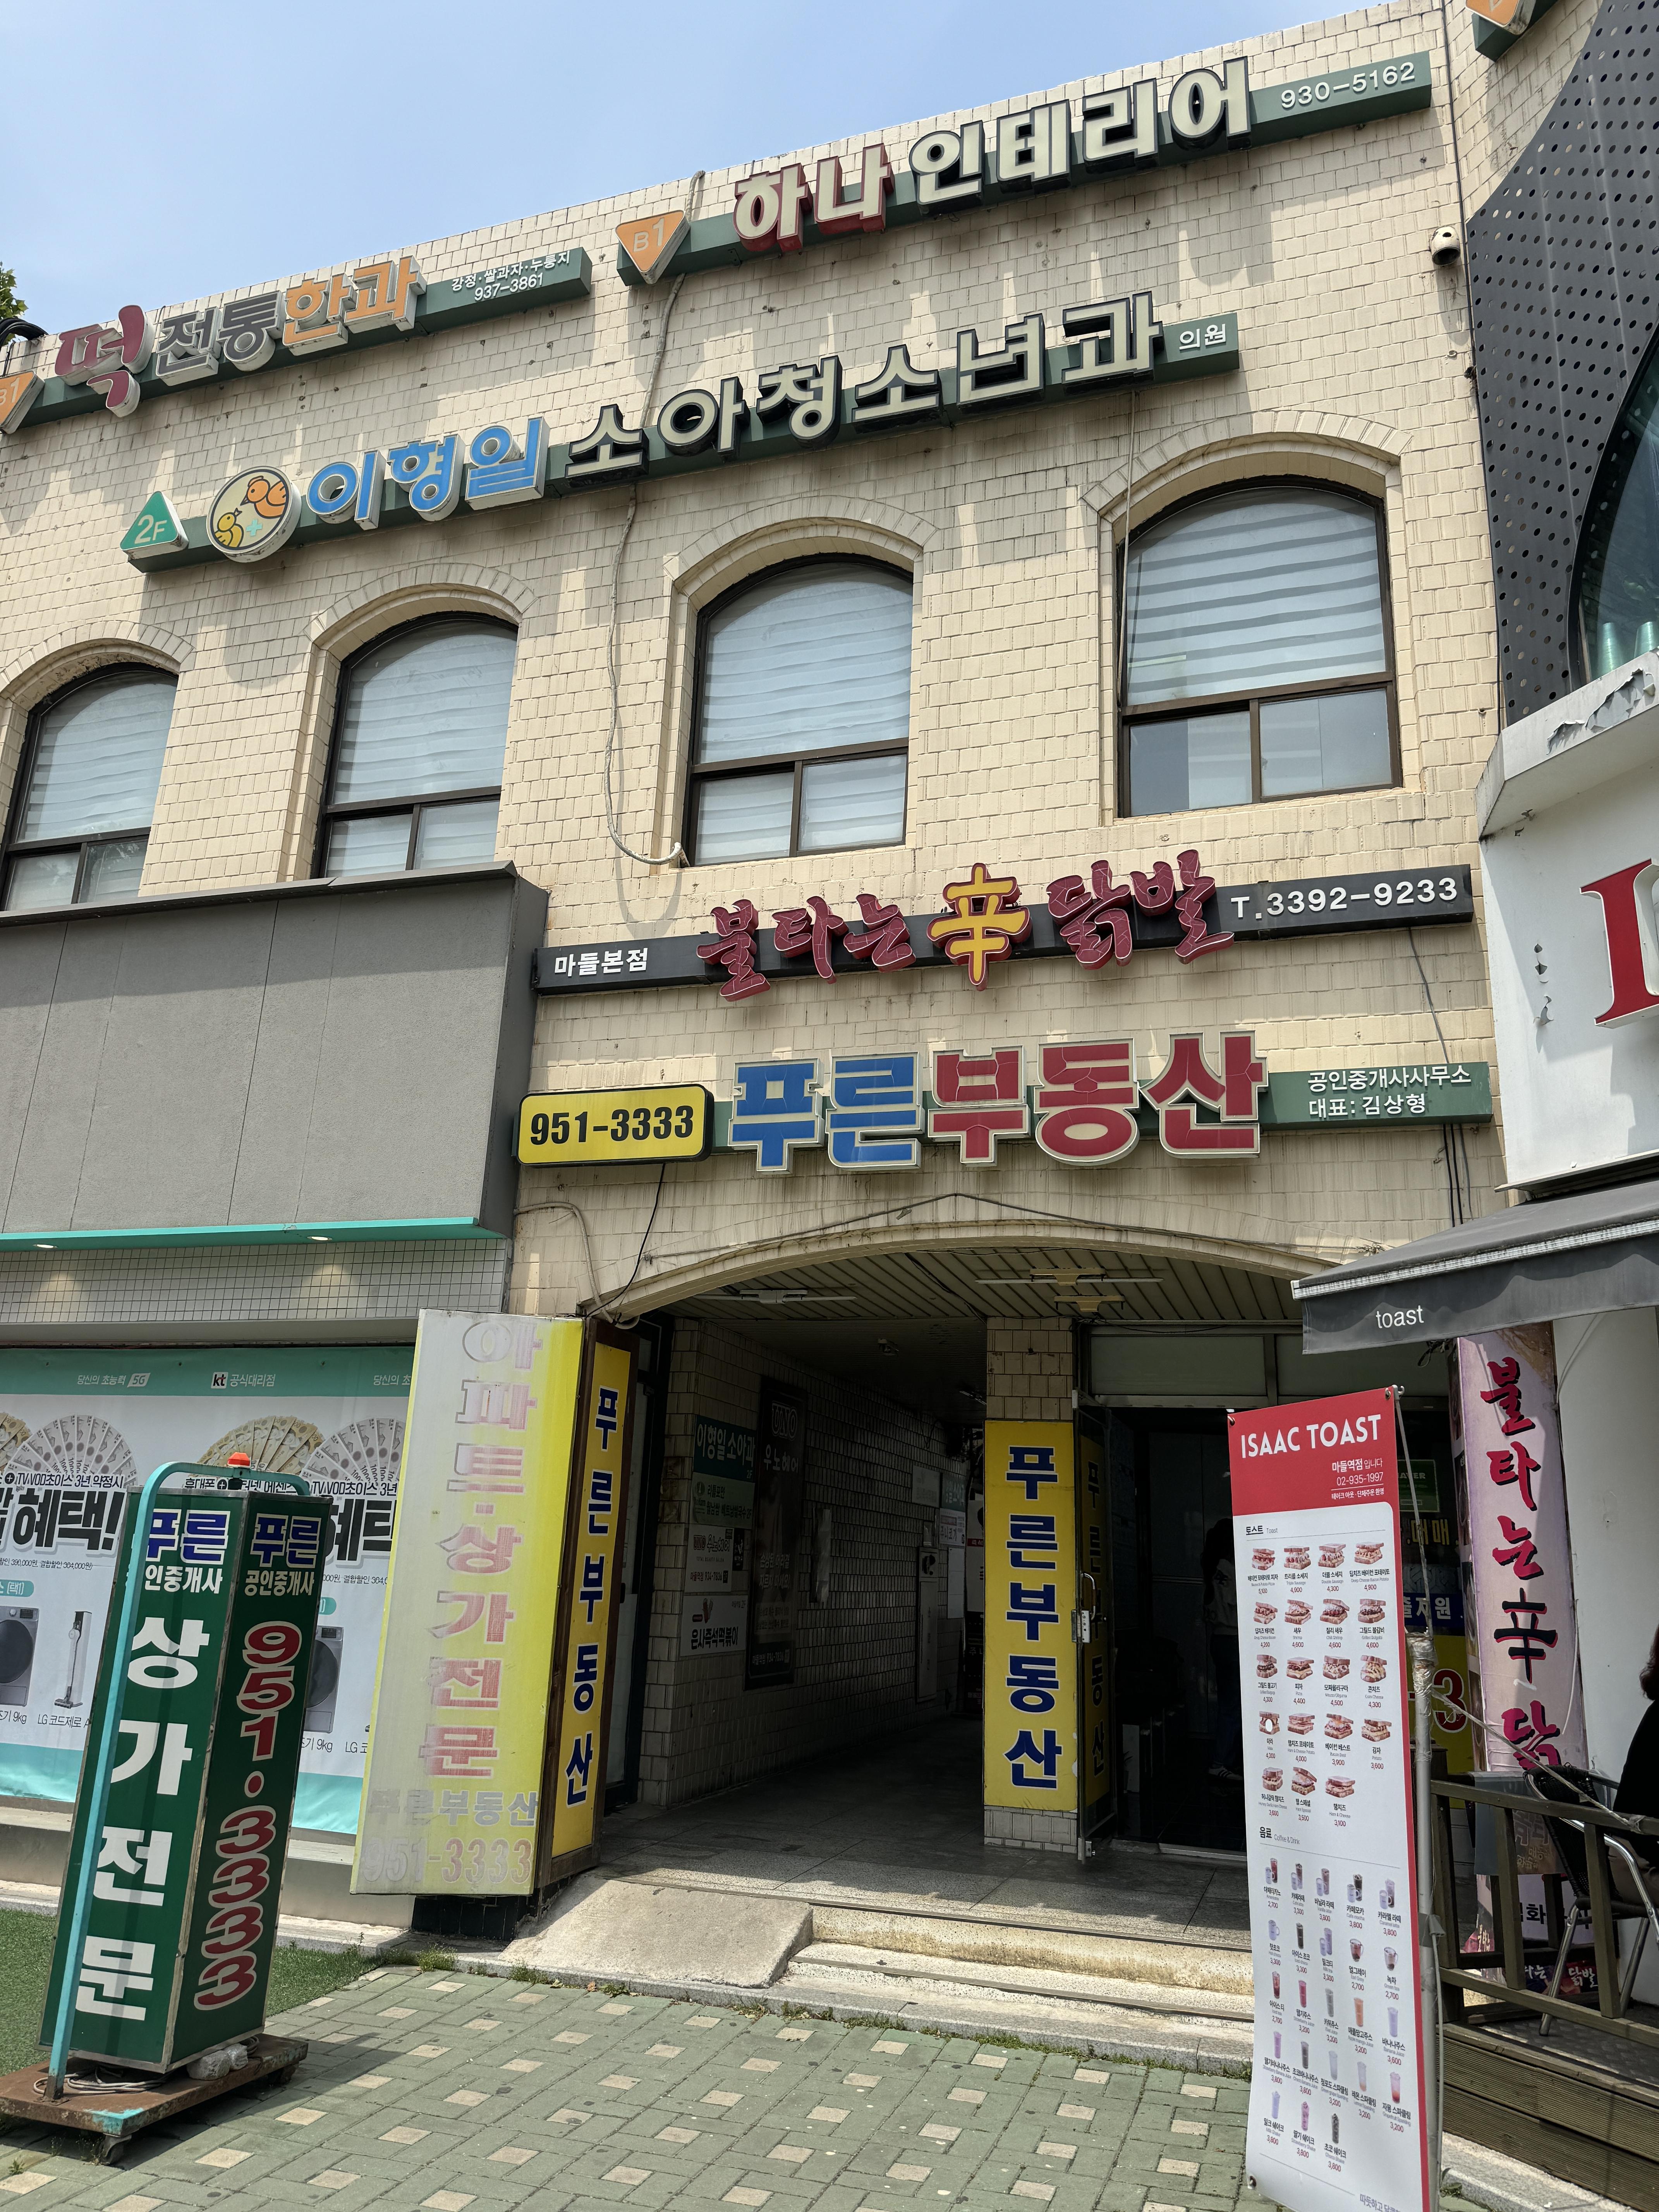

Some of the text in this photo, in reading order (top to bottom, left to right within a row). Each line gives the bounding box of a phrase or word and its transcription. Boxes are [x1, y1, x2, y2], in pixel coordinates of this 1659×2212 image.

[1281, 62, 1415, 110] 930-5162
[633, 216, 665, 253] B1
[474, 272, 543, 301] 937-3861
[1178, 323, 1226, 351] 의원
[135, 513, 167, 545] 2F
[554, 947, 649, 977] 마들본점
[1307, 1064, 1472, 1094] 공인중개사사무소
[1362, 1092, 1427, 1116] 김상형
[530, 1105, 694, 1146] 951-3333
[1376, 1305, 1424, 1329] toast
[77, 1373, 146, 1386] 당신의 초능력 5G
[212, 1373, 276, 1388] kt 공식대리점
[373, 1374, 399, 1386] 당신의
[771, 1400, 798, 1441] UNO
[1241, 1414, 1382, 1459] ISAAC TOAST
[697, 1424, 756, 1468] 이형일 소아과
[763, 1444, 799, 1474] 우노헤어
[1331, 1457, 1383, 1473] 마들역점 입니다
[74, 1475, 91, 1487] 3년
[93, 1475, 124, 1489] 약정시
[1336, 1472, 1384, 1486] 02-935-1997
[12, 1488, 125, 1551] 혜택!
[145, 1508, 230, 1565] 푸른
[1246, 1525, 1264, 1535] 토스트
[250, 1513, 322, 1569] 푸른
[144, 1565, 223, 1594] 인중개사
[244, 1569, 315, 1597] 공인중개사
[565, 1386, 618, 1807] 푸른부동산
[1003, 1445, 1063, 1790] 푸른부동산
[13, 1711, 82, 1728] 9kg LG 코드제로
[345, 1740, 359, 1753] LG
[76, 1617, 210, 2021] 상가전문
[1259, 1826, 1272, 1839] 음료
[362, 1835, 532, 1886] 951-3333
[1267, 1901, 1278, 1909] 2,700
[1346, 1905, 1364, 1915] 카페모카
[1349, 1920, 1362, 1929] 3,800
[1383, 1928, 1397, 1937] 3,800
[1349, 1965, 1366, 1978] 얼그레이
[1387, 1975, 1396, 1985] 녹차
[1352, 1982, 1364, 1991] 2,700
[1385, 1990, 1399, 2000] 2,700
[1355, 2044, 1367, 2054] 3,200
[1382, 2037, 1406, 2051] 바나나주스
[1387, 2055, 1401, 2065] 3,600
[1382, 2102, 1391, 2113] 자몽
[1392, 2107, 1411, 2120] 스파클링
[1390, 2122, 1404, 2133] 3,200
[1267, 2135, 1279, 2145] 3,800
[1297, 2148, 1309, 2158] 3,800
[1328, 2161, 1341, 2172] 3,800
